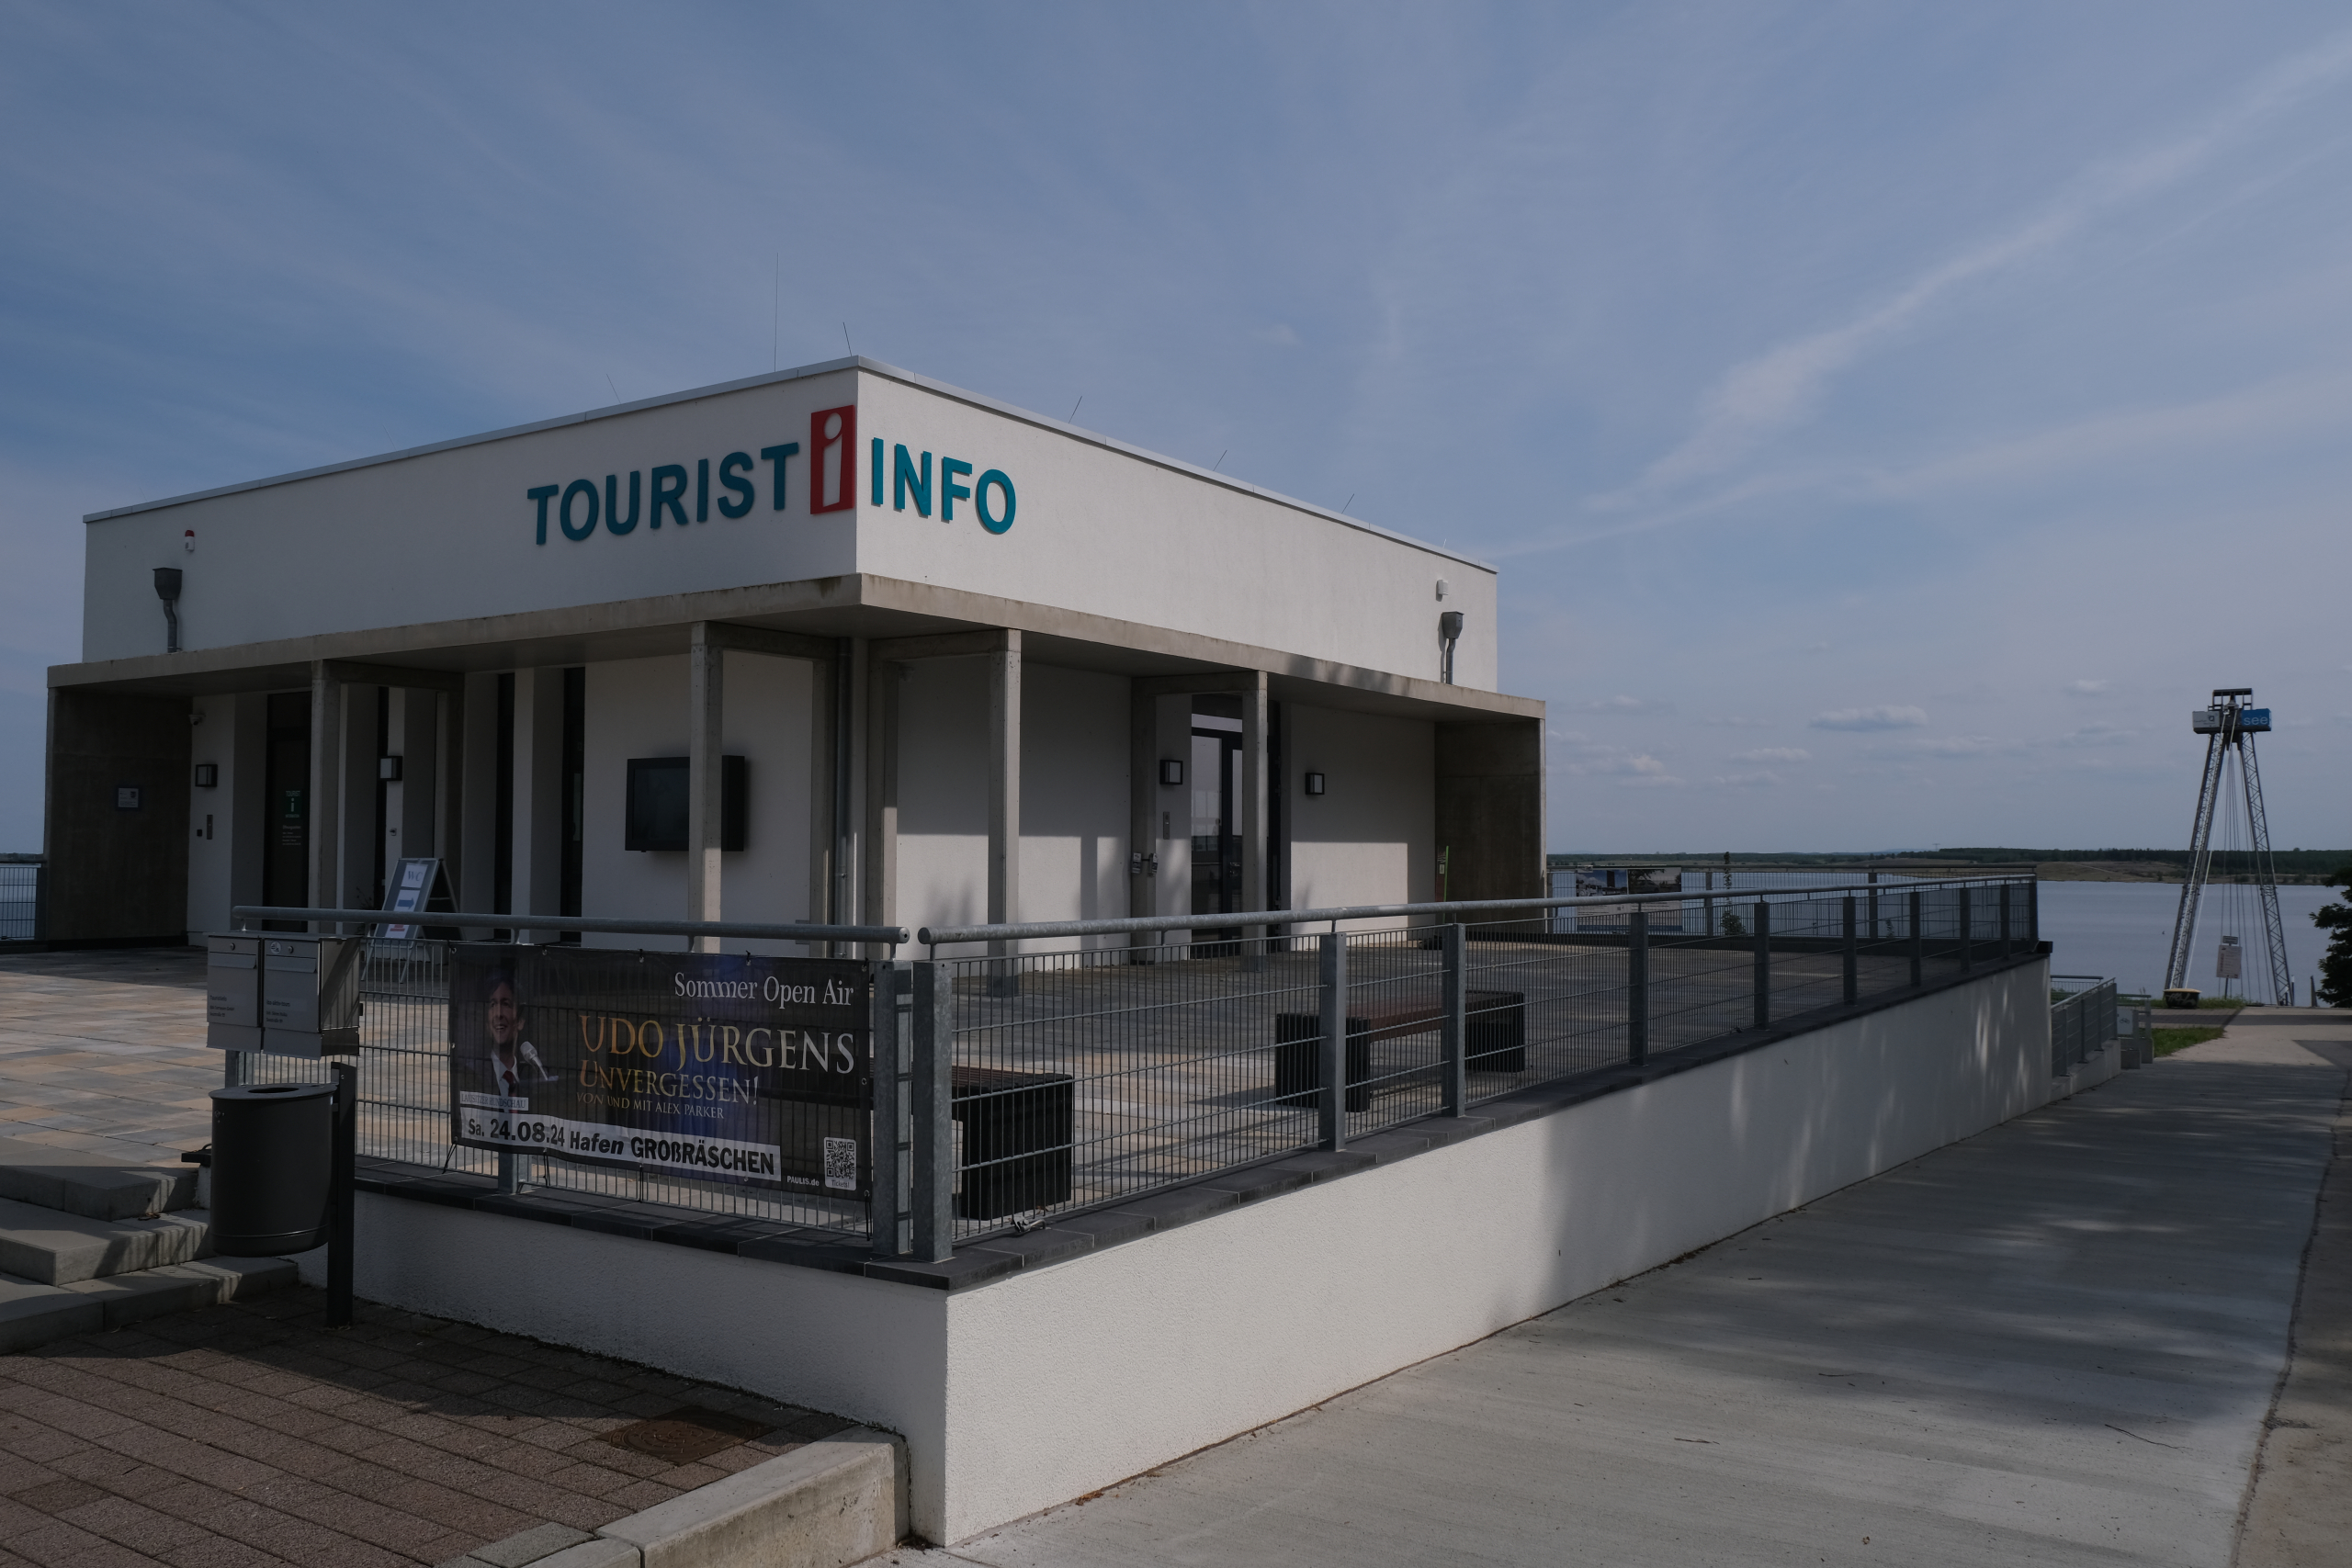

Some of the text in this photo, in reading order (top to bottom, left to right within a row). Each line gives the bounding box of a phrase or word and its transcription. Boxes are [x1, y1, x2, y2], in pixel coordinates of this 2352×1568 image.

[527, 442, 799, 546] TOURIST
[871, 436, 1017, 535] INFO
[2244, 716, 2268, 726] see
[407, 870, 424, 882] WC
[674, 972, 854, 1010] Sommer Open Air
[579, 1015, 854, 1074] UDO JÜRGENS
[580, 1059, 758, 1105] UNVERGESSEN!
[461, 1092, 526, 1109] LAUSITZER RUNDSCHAU
[576, 1091, 724, 1119] VON UND MIT ALEX PARKER
[468, 1118, 775, 1175] Sa. 24.08.24 Hafen GROßRÄSCHEN
[786, 1175, 820, 1187] PAULIS.de
